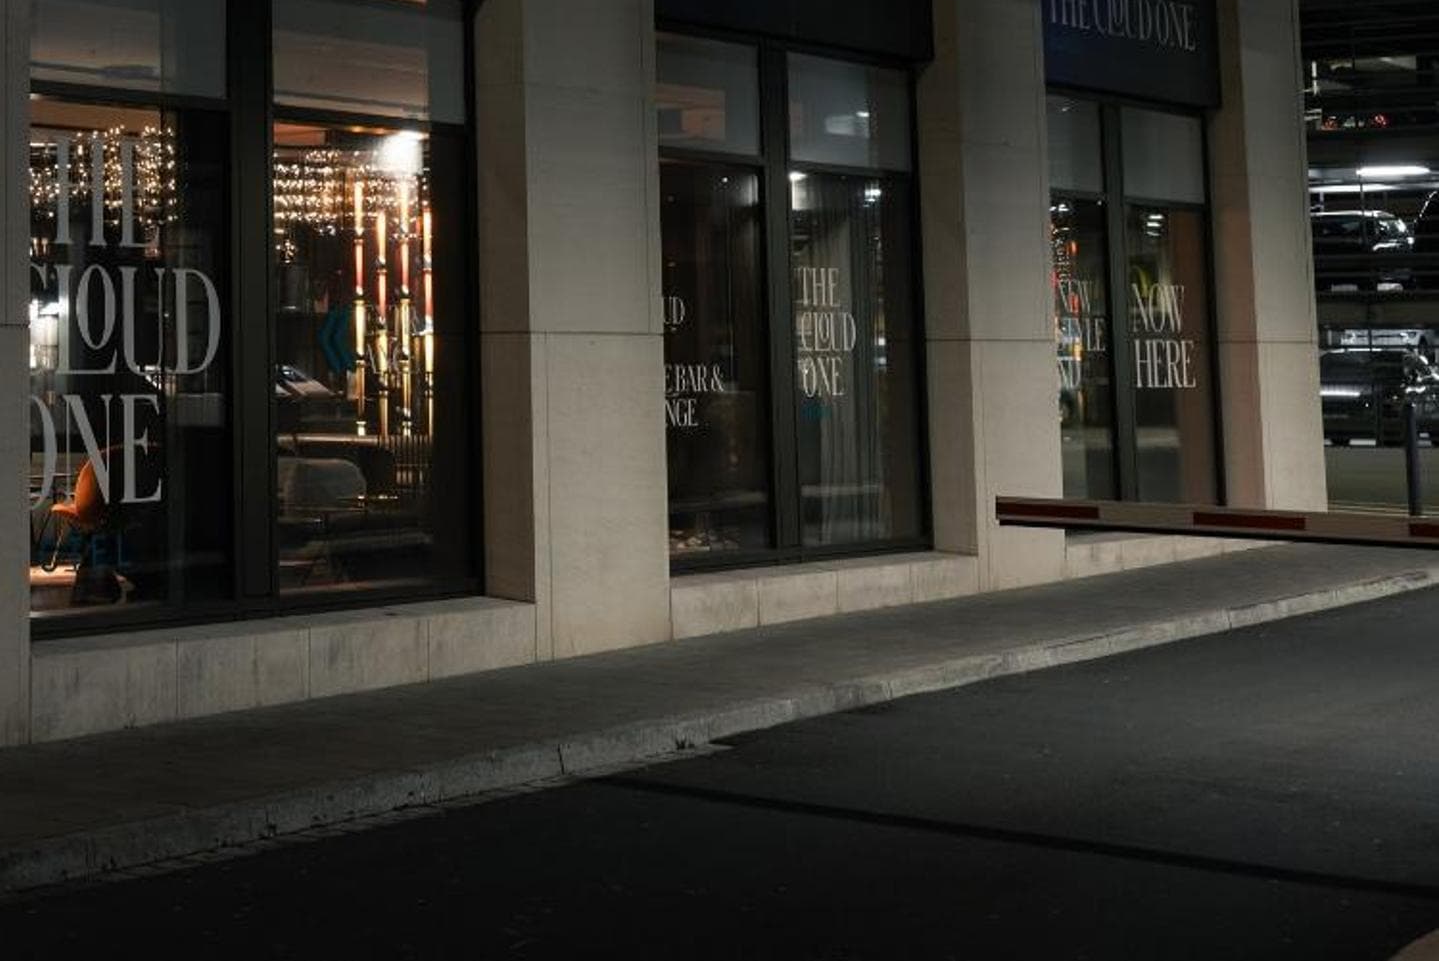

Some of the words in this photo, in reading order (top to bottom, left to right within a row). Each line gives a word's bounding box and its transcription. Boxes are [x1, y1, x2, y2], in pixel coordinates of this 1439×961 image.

[44, 138, 161, 247] THE
[798, 267, 841, 308] THE
[1132, 283, 1186, 333] NOW
[801, 311, 857, 352] CLOUD
[675, 363, 709, 392] BAR
[710, 362, 724, 392] &
[803, 357, 845, 398] ONE
[1134, 339, 1197, 389] HERE
